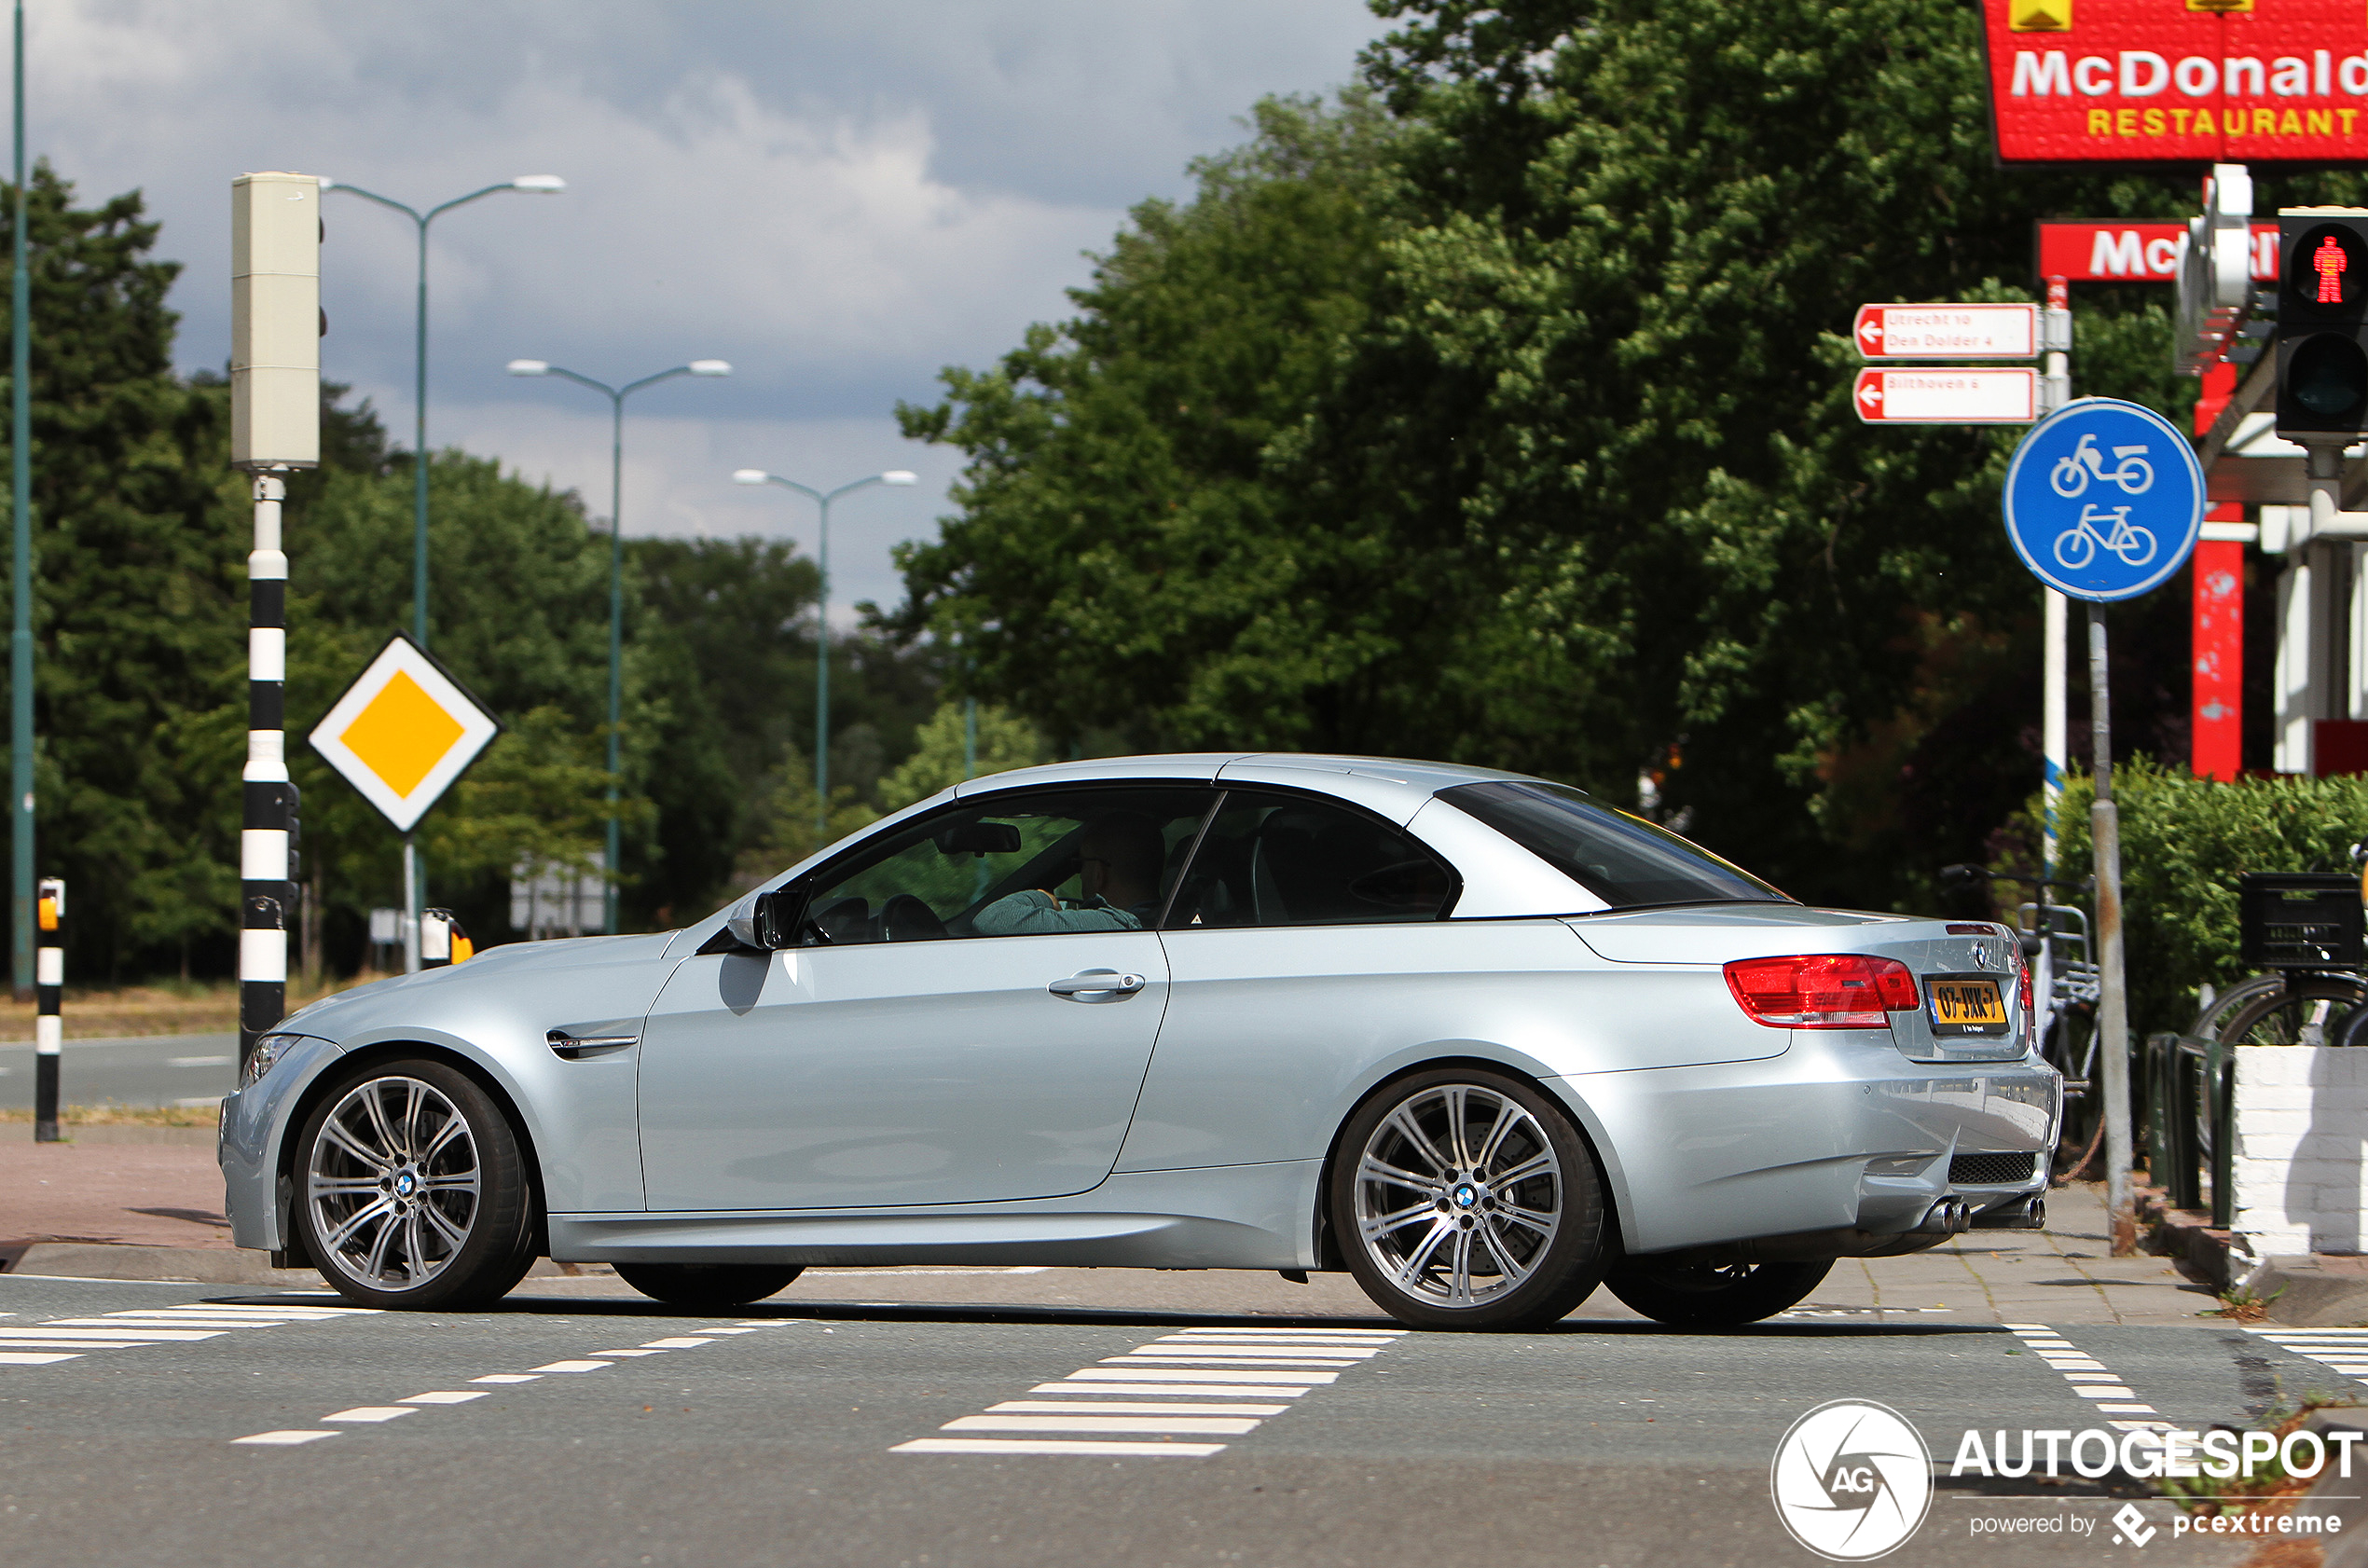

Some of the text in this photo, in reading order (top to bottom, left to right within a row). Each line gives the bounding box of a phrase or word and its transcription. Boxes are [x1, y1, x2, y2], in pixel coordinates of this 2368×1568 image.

[2087, 108, 2359, 136] RESTAURANT
[1887, 314, 1971, 325] Utrecht 10
[1887, 335, 1919, 347] Den
[1924, 334, 1980, 347] Dolder
[1887, 377, 1965, 389] Bilthoven
